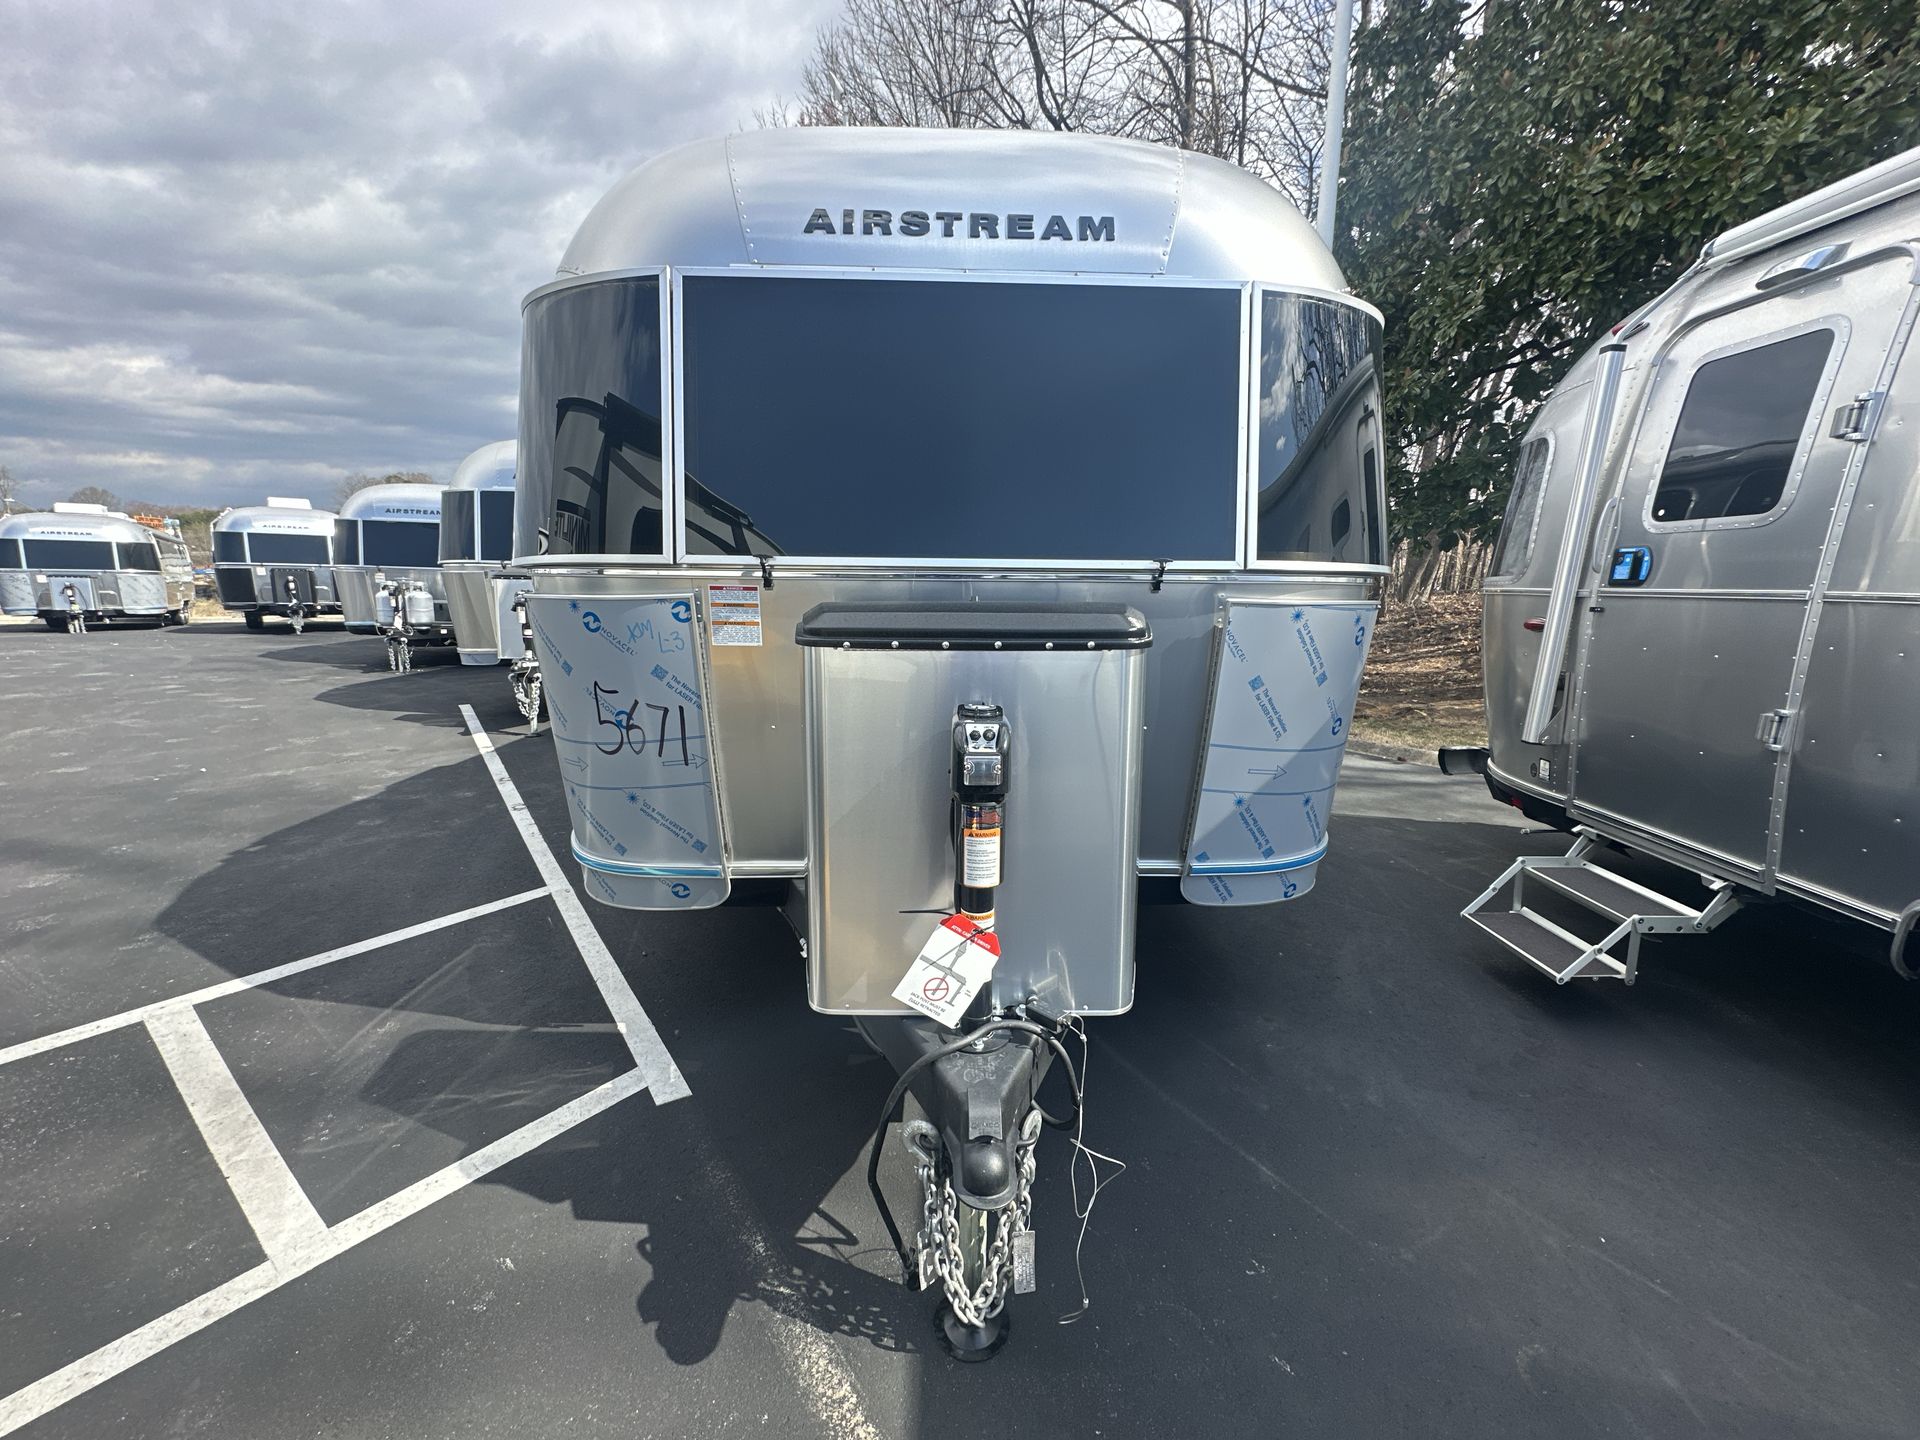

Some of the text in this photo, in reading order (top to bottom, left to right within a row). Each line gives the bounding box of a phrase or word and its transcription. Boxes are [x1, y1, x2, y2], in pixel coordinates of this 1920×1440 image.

[803, 208, 1116, 242] AIRSTREAM
[601, 627, 634, 655] NOVACEL
[671, 675, 681, 685] The
[666, 682, 674, 690] for
[675, 688, 693, 702] LASER
[594, 680, 689, 766] 5671
[1259, 701, 1270, 716] LASER
[1267, 715, 1275, 727] Fiber
[669, 820, 686, 833] LASER
[977, 939, 990, 948] DRIVER
